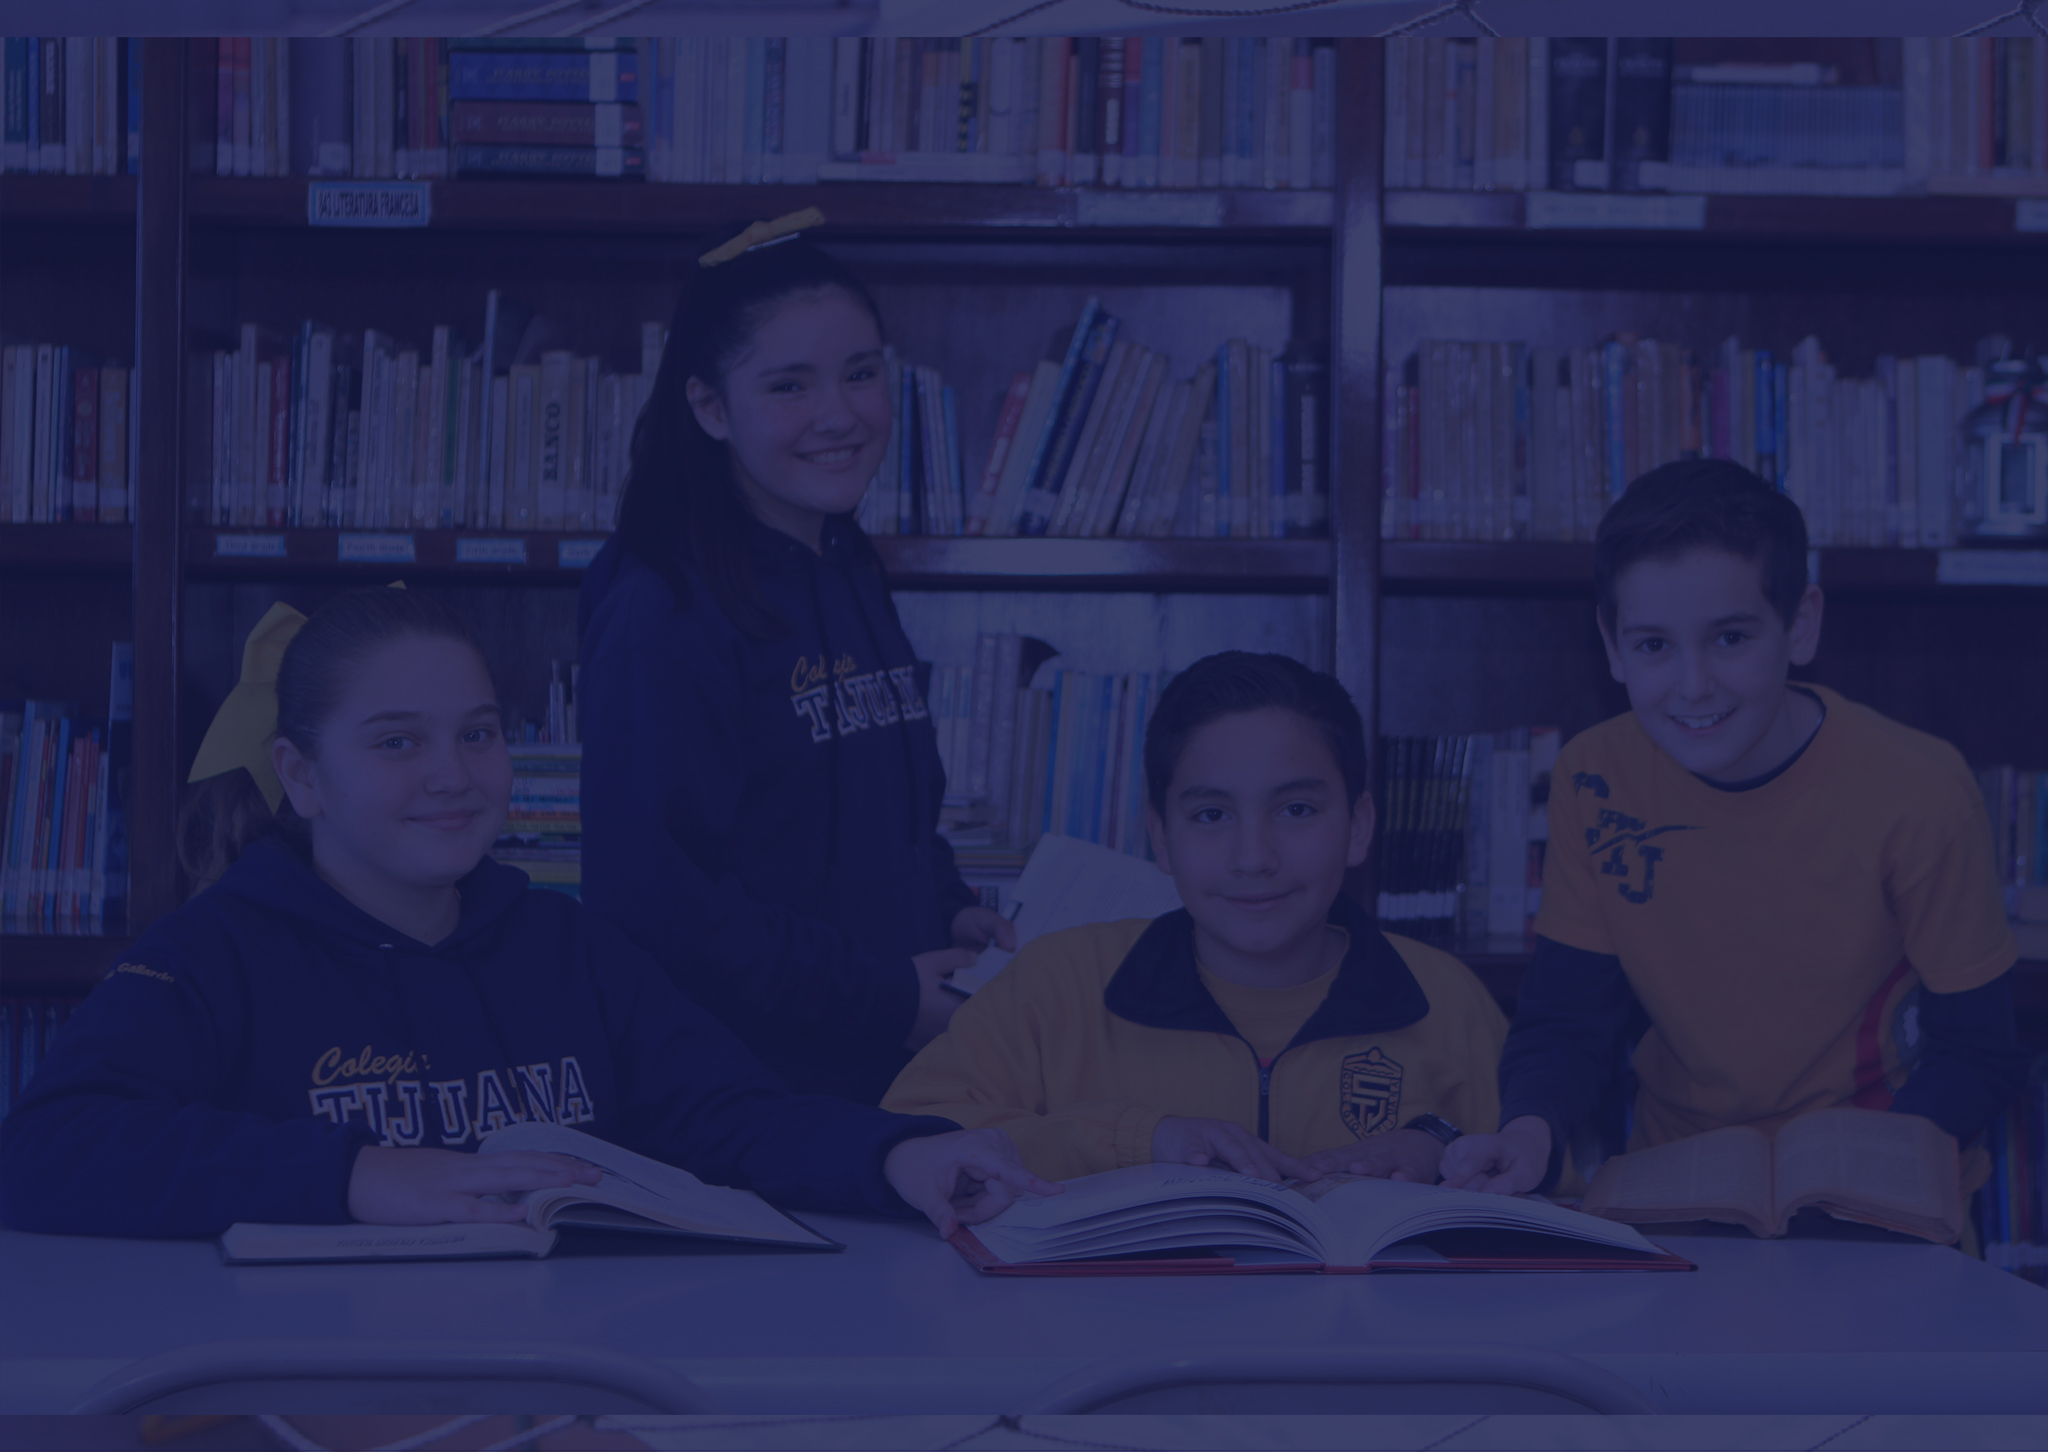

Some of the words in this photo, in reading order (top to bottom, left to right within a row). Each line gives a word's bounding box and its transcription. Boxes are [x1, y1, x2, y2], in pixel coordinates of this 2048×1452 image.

[334, 192, 379, 216] LITERATURA
[381, 192, 419, 216] FRANCESA
[543, 402, 561, 483] BANCO
[226, 541, 247, 551] Third
[347, 541, 375, 552] Fourth
[791, 653, 857, 692] Colgio
[790, 665, 928, 743] TIJUAN
[116, 962, 176, 983] Gallardo
[308, 1056, 595, 1147] TIJUANA
[1343, 1072, 1360, 1131] COLEGIO
